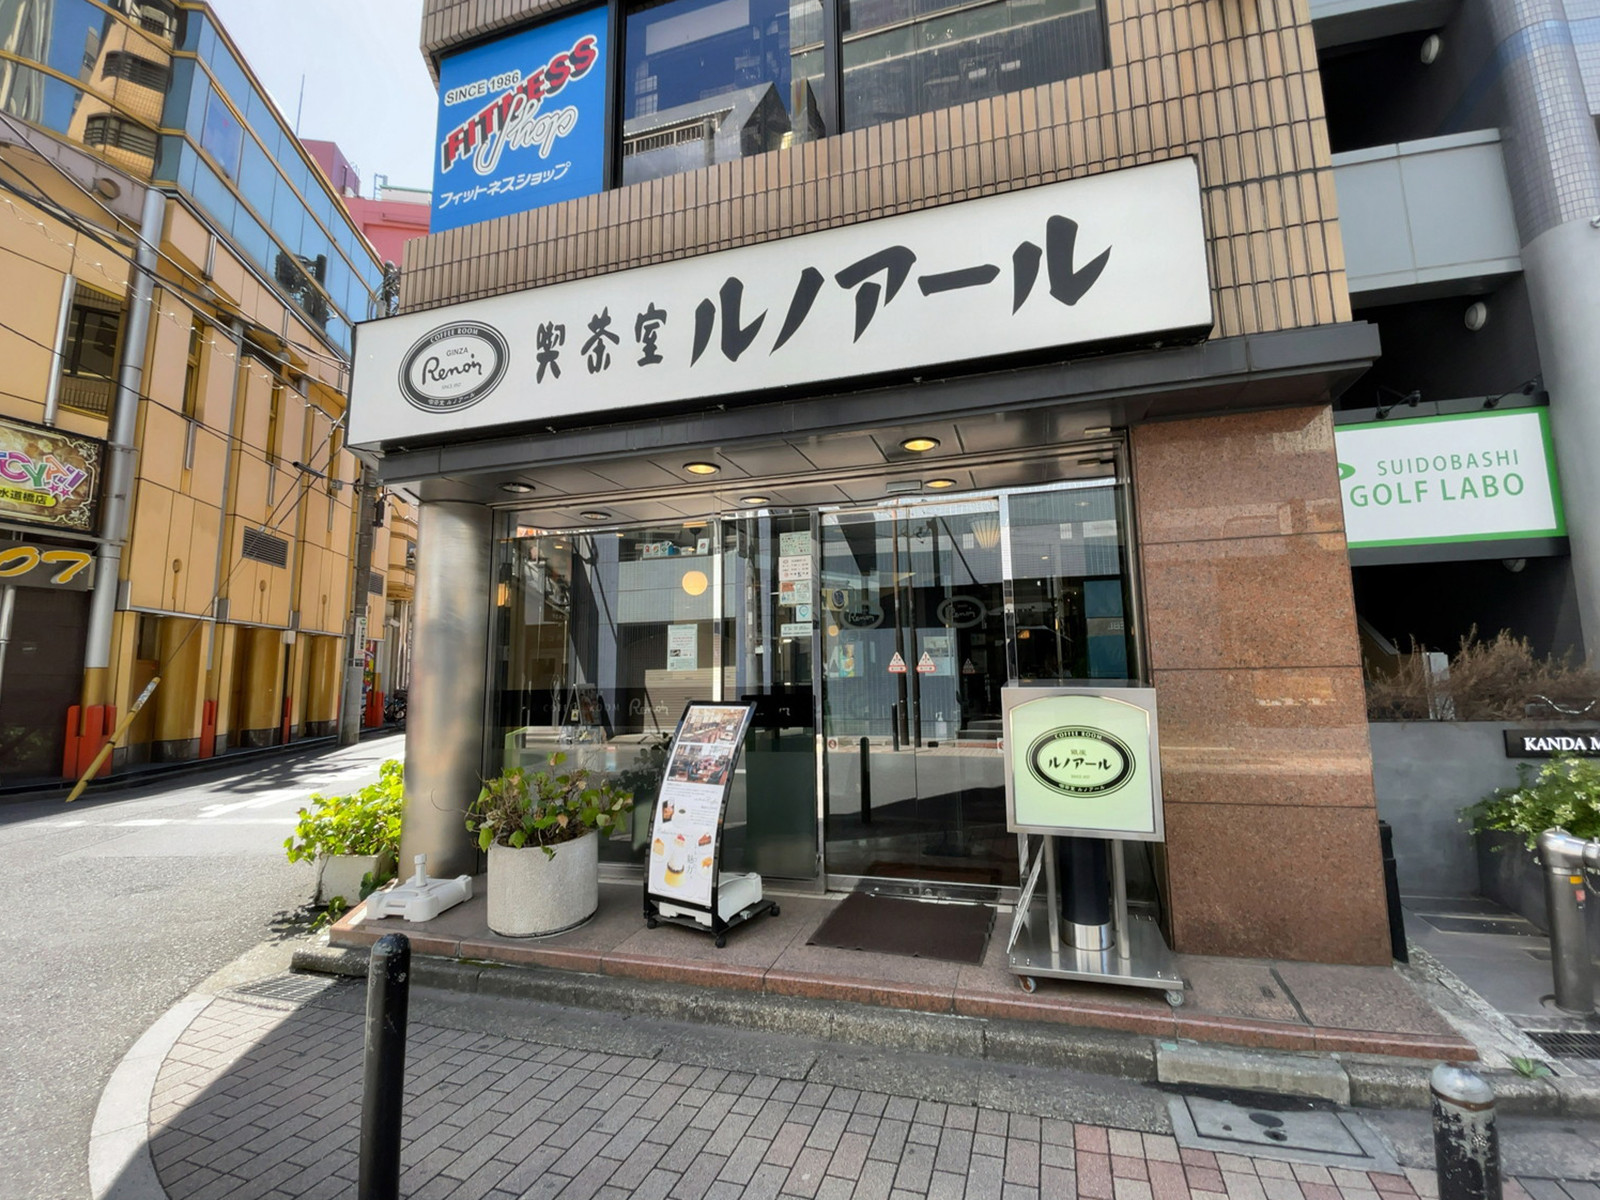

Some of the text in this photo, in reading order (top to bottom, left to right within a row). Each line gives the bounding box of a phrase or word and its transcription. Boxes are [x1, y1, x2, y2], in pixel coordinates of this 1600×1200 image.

[445, 71, 520, 105] SINCE 1986
[442, 35, 598, 173] FITNESS
[438, 160, 572, 210] フィットネスショップ
[536, 214, 1113, 385] 喫茶室 ルノアール
[430, 327, 479, 343] COFFEE ROOM
[445, 346, 469, 357] GINZA
[1377, 449, 1519, 476] SUIDOBASHI
[0, 487, 48, 505] 水道橋店
[1350, 472, 1525, 507] GOLF LABO
[1524, 737, 1587, 751] KANDA
[1049, 756, 1112, 771] ルノアール
